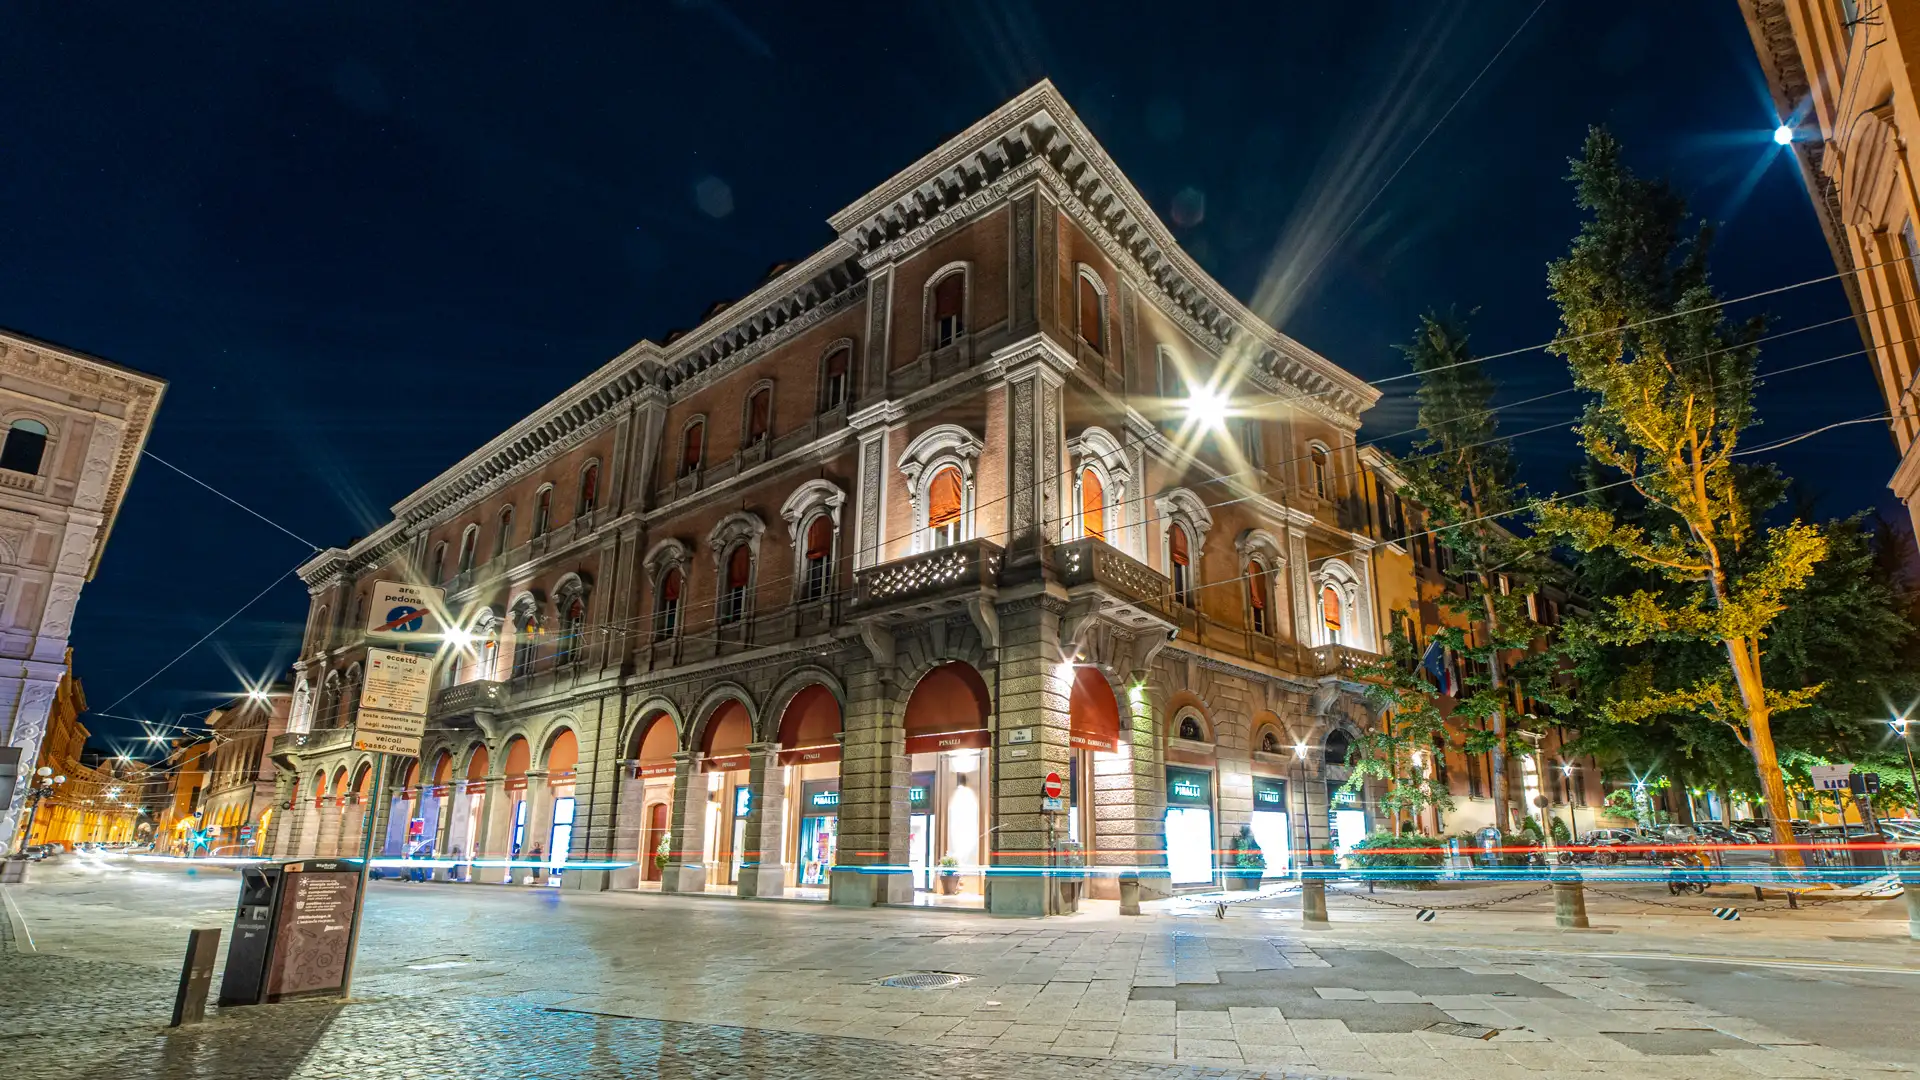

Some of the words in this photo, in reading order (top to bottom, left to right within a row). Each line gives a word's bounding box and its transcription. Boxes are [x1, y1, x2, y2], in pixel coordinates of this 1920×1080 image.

[398, 587, 421, 595] area
[386, 655, 418, 664] eccetto
[380, 715, 409, 723] consentita
[375, 736, 402, 744] veicoli
[938, 738, 961, 747] PINALLI
[389, 744, 418, 753] d'uomo
[1175, 785, 1200, 797] PINALLI
[813, 795, 839, 805] PINALLI
[1259, 792, 1279, 803] PINALLI
